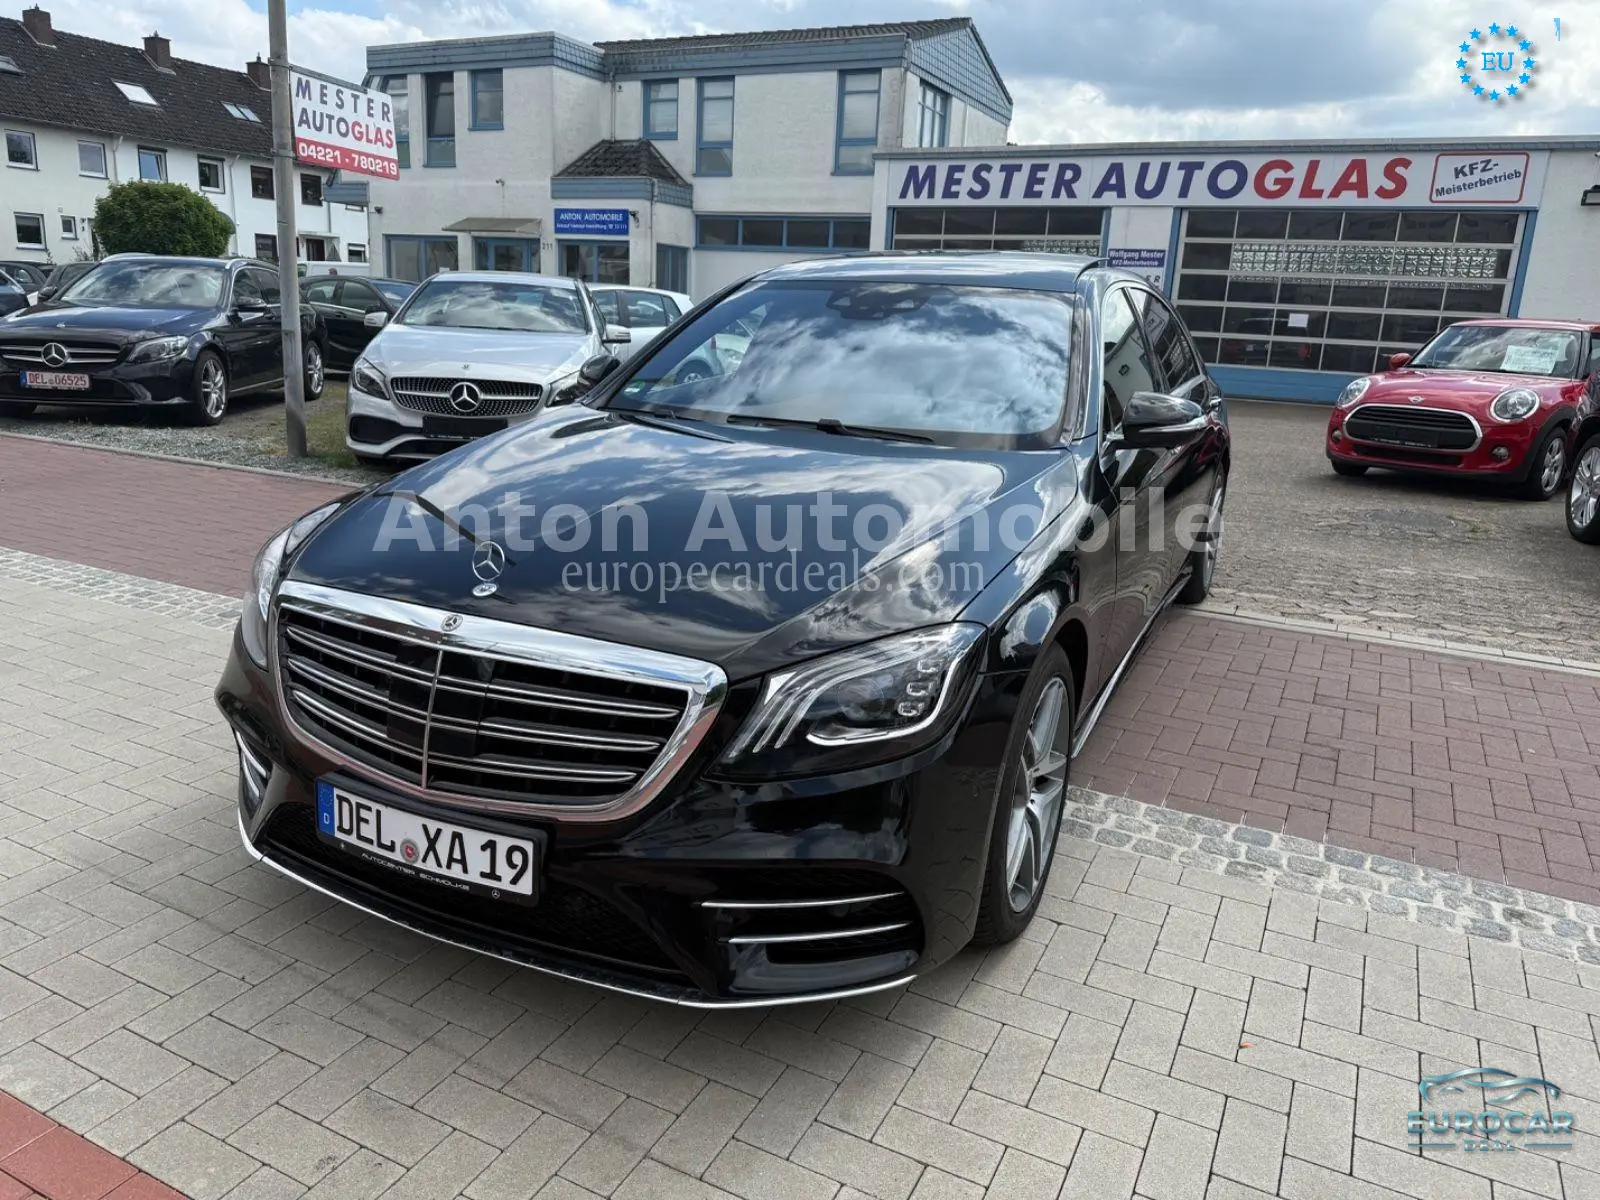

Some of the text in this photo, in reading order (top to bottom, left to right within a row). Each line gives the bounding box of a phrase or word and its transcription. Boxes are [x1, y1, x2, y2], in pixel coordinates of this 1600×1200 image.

[296, 77, 391, 122] MESTER
[298, 107, 393, 149] AUTOGLAS
[299, 143, 397, 175] 04221 780219
[1453, 158, 1499, 179] KFZ-
[899, 158, 1413, 200] MESTER AUTOGLAS
[1435, 169, 1522, 197] Meisterbetrieb
[560, 213, 623, 221] ANTON AUTOMOBILE
[1109, 250, 1164, 259] Wolfgang Mester
[335, 794, 530, 886] DEL XA 19
[361, 853, 416, 876] AUTOCENTER
